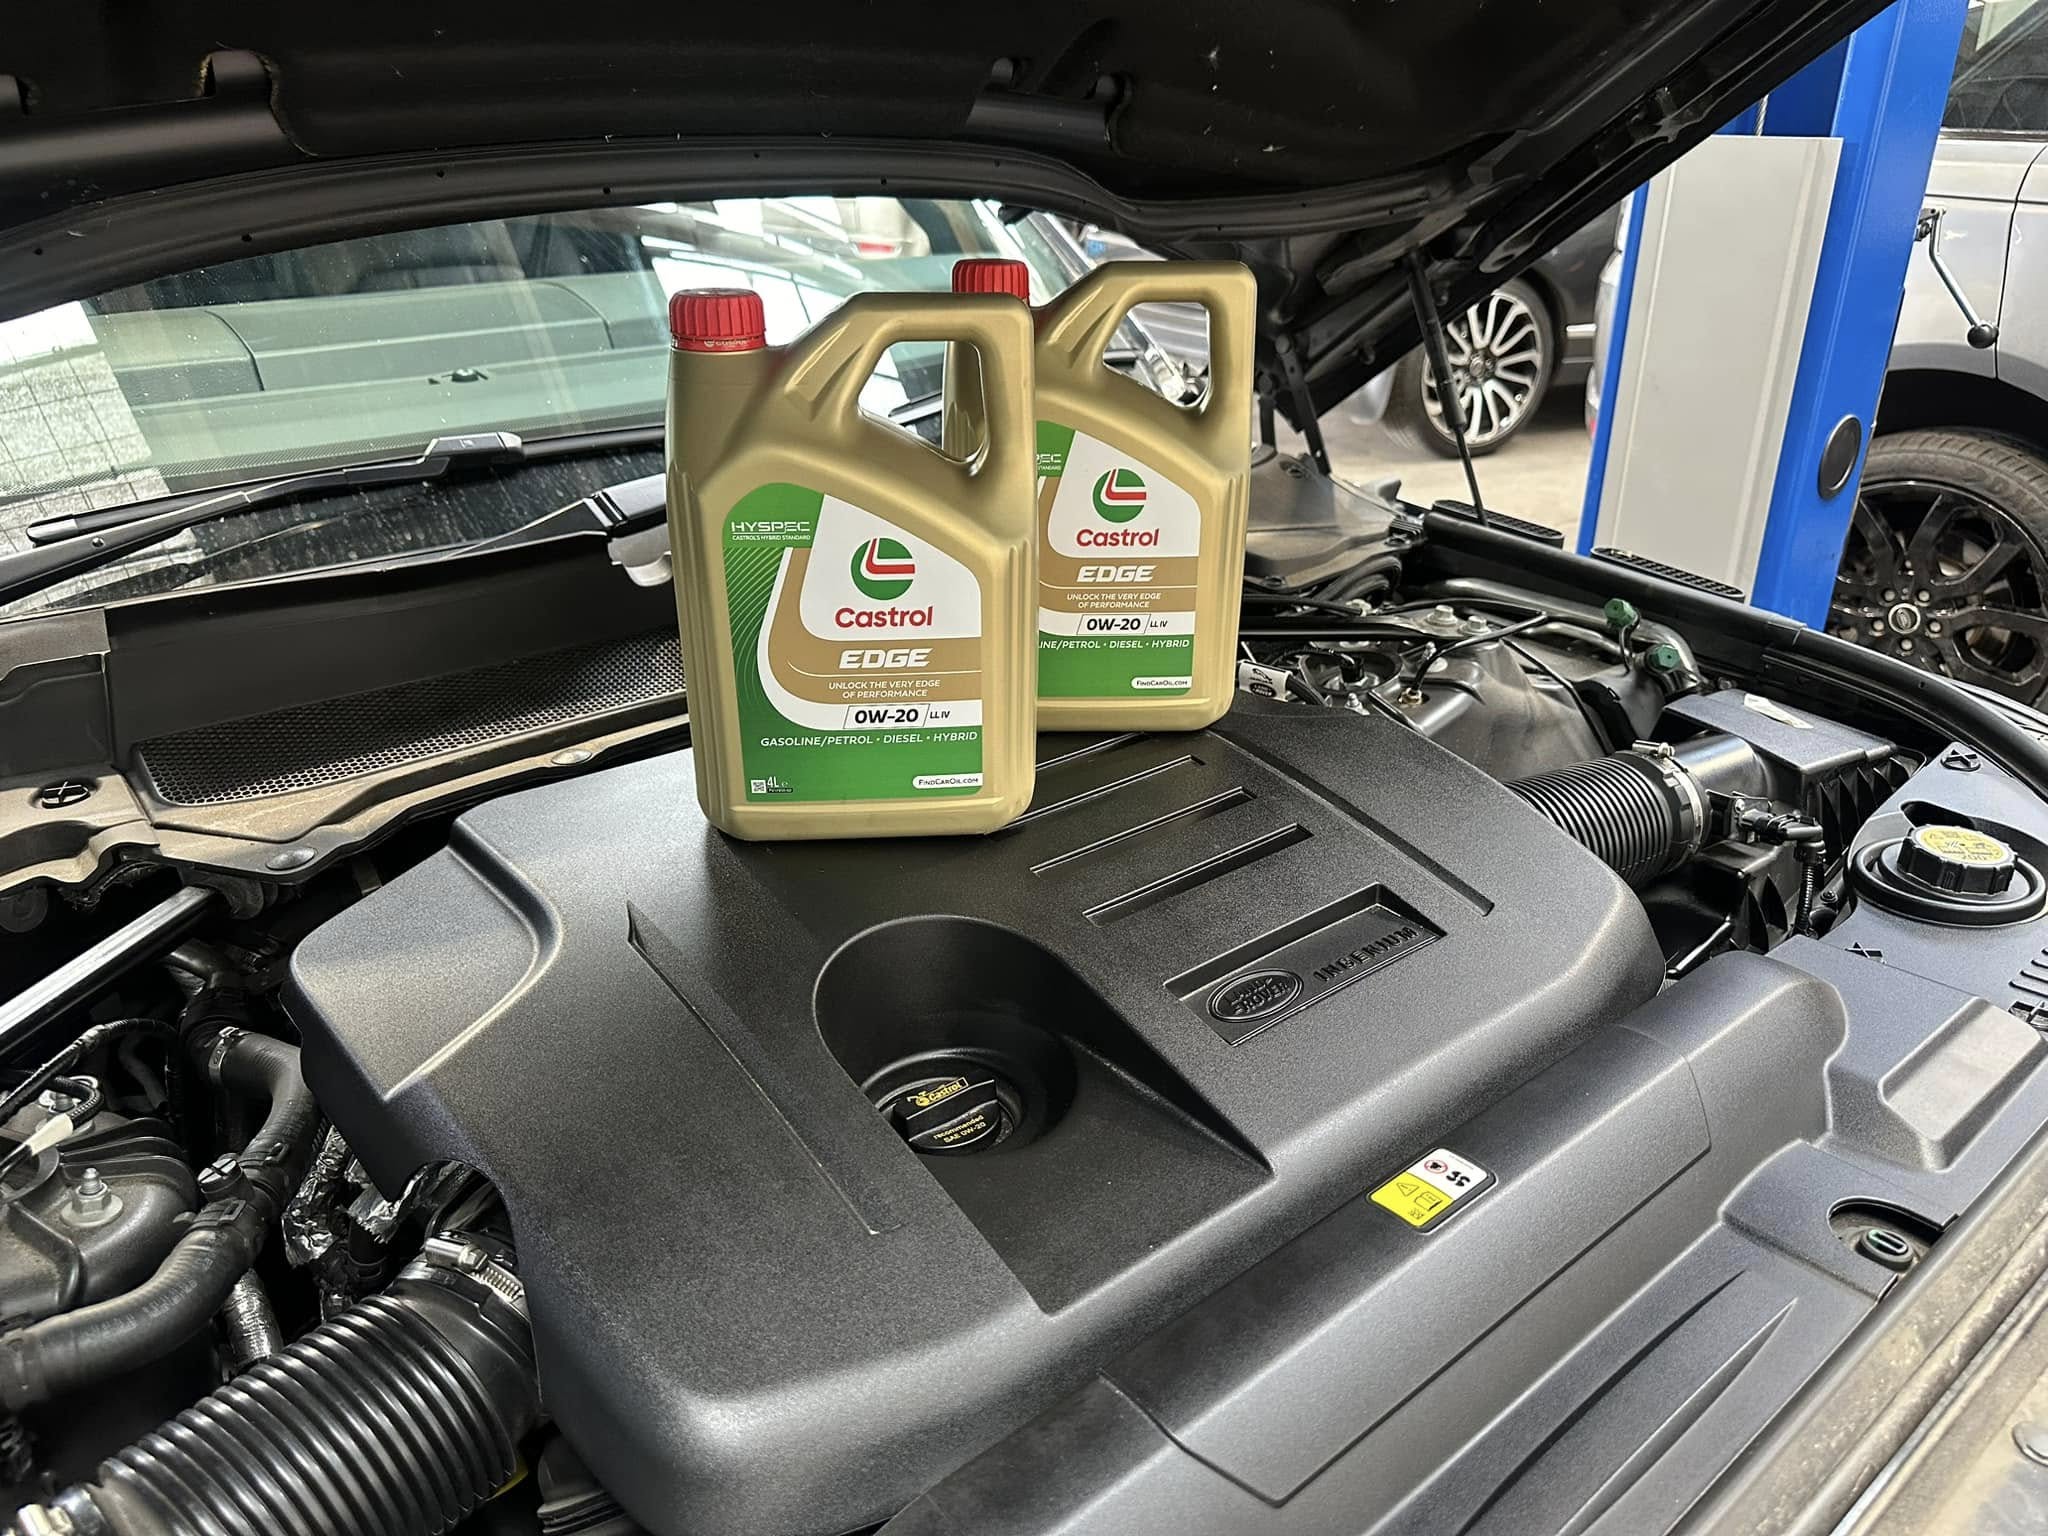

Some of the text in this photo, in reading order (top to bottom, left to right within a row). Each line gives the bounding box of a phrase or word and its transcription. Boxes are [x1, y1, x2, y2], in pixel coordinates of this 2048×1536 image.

[731, 521, 810, 532] HYSPEC
[1076, 528, 1159, 547] Castrol
[1076, 565, 1157, 583] EDGE
[1067, 593, 1100, 601] UNLOCK
[1140, 592, 1161, 600] EDGE
[1078, 600, 1151, 609] OF PERFORMANCE
[835, 606, 933, 628] Castrol
[1087, 618, 1141, 630] 0W-20
[1039, 639, 1190, 650] INE/PETROL DIESEL HYBRID
[839, 648, 933, 669] EDGE
[828, 679, 941, 690] UNLOCK THE VERY EDGE
[842, 689, 928, 699] OF PERFORMANCE
[854, 708, 919, 724] 0W-20
[760, 731, 978, 748] GASOLINE/PETROL DIESEL HYBRID
[767, 776, 780, 788] 4L
[928, 1081, 961, 1101] Castrol
[933, 1115, 984, 1140] recommended
